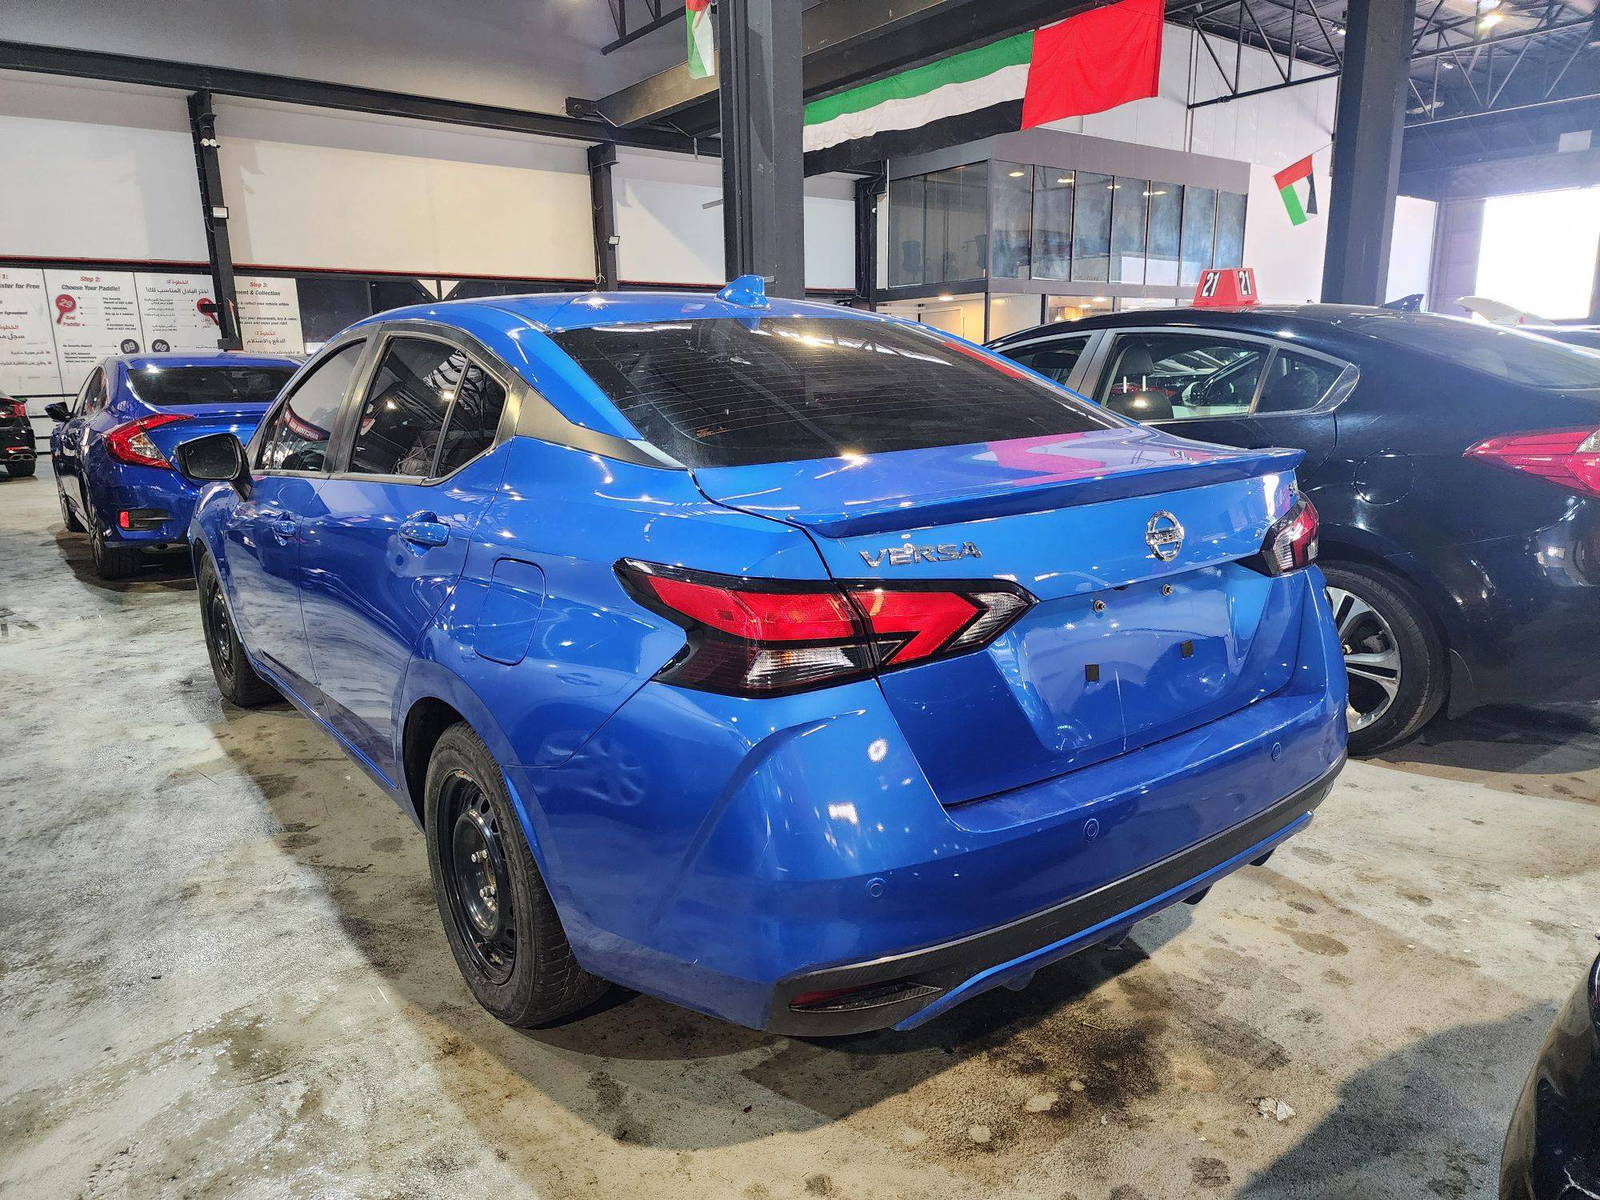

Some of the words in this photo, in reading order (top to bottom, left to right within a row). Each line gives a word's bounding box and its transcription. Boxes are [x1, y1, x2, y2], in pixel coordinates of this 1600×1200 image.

[1202, 272, 1220, 297] 21
[1239, 270, 1252, 295] 21
[124, 342, 135, 352] 09
[155, 343, 167, 351] 09
[859, 542, 983, 568] VERSA
